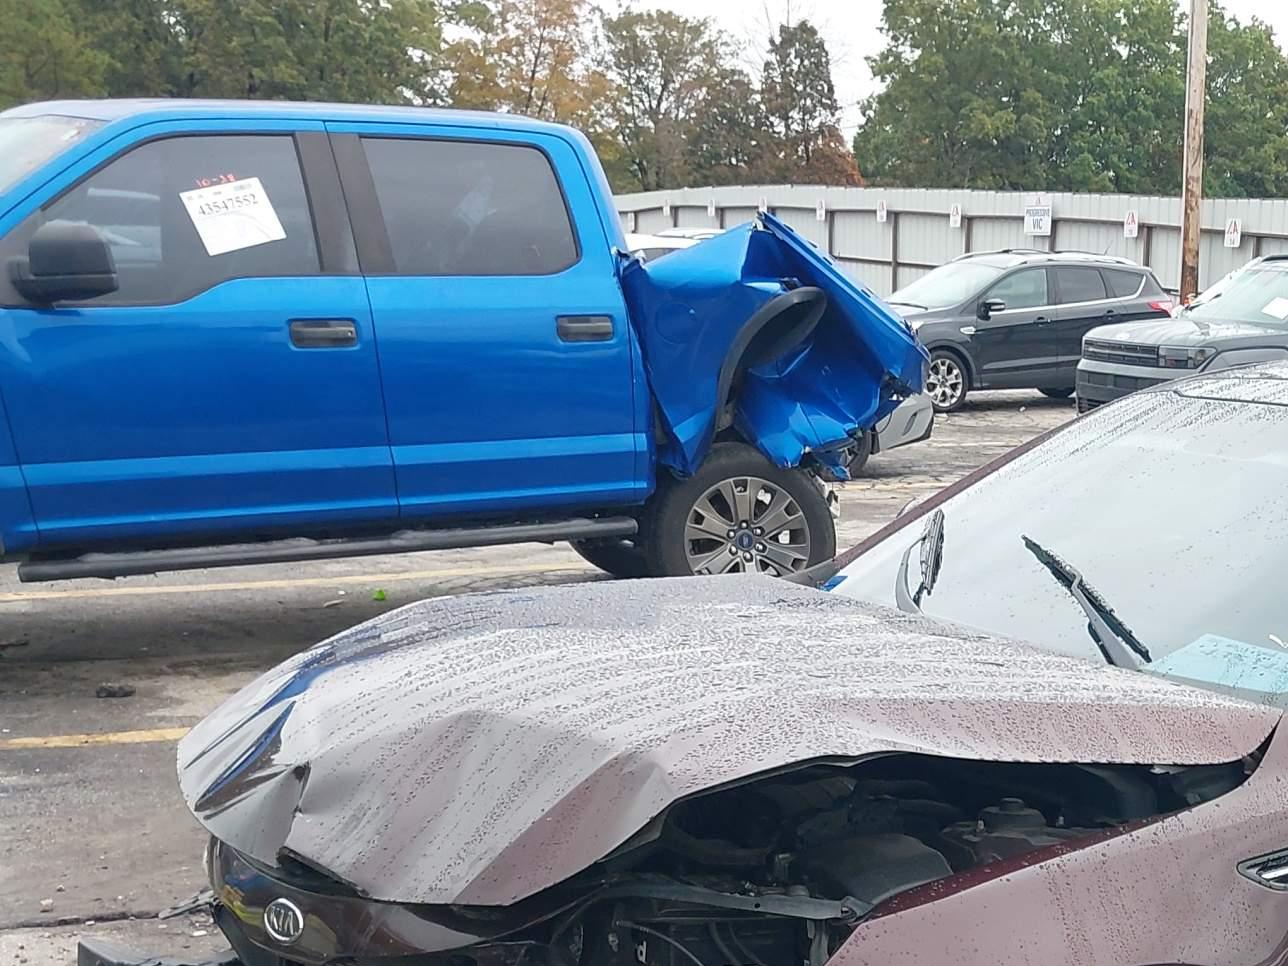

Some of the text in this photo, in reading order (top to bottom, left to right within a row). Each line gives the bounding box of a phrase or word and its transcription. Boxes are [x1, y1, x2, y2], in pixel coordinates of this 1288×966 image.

[198, 193, 259, 216] 43547552
[1032, 217, 1043, 230] VIC
[269, 905, 296, 937] KIA
